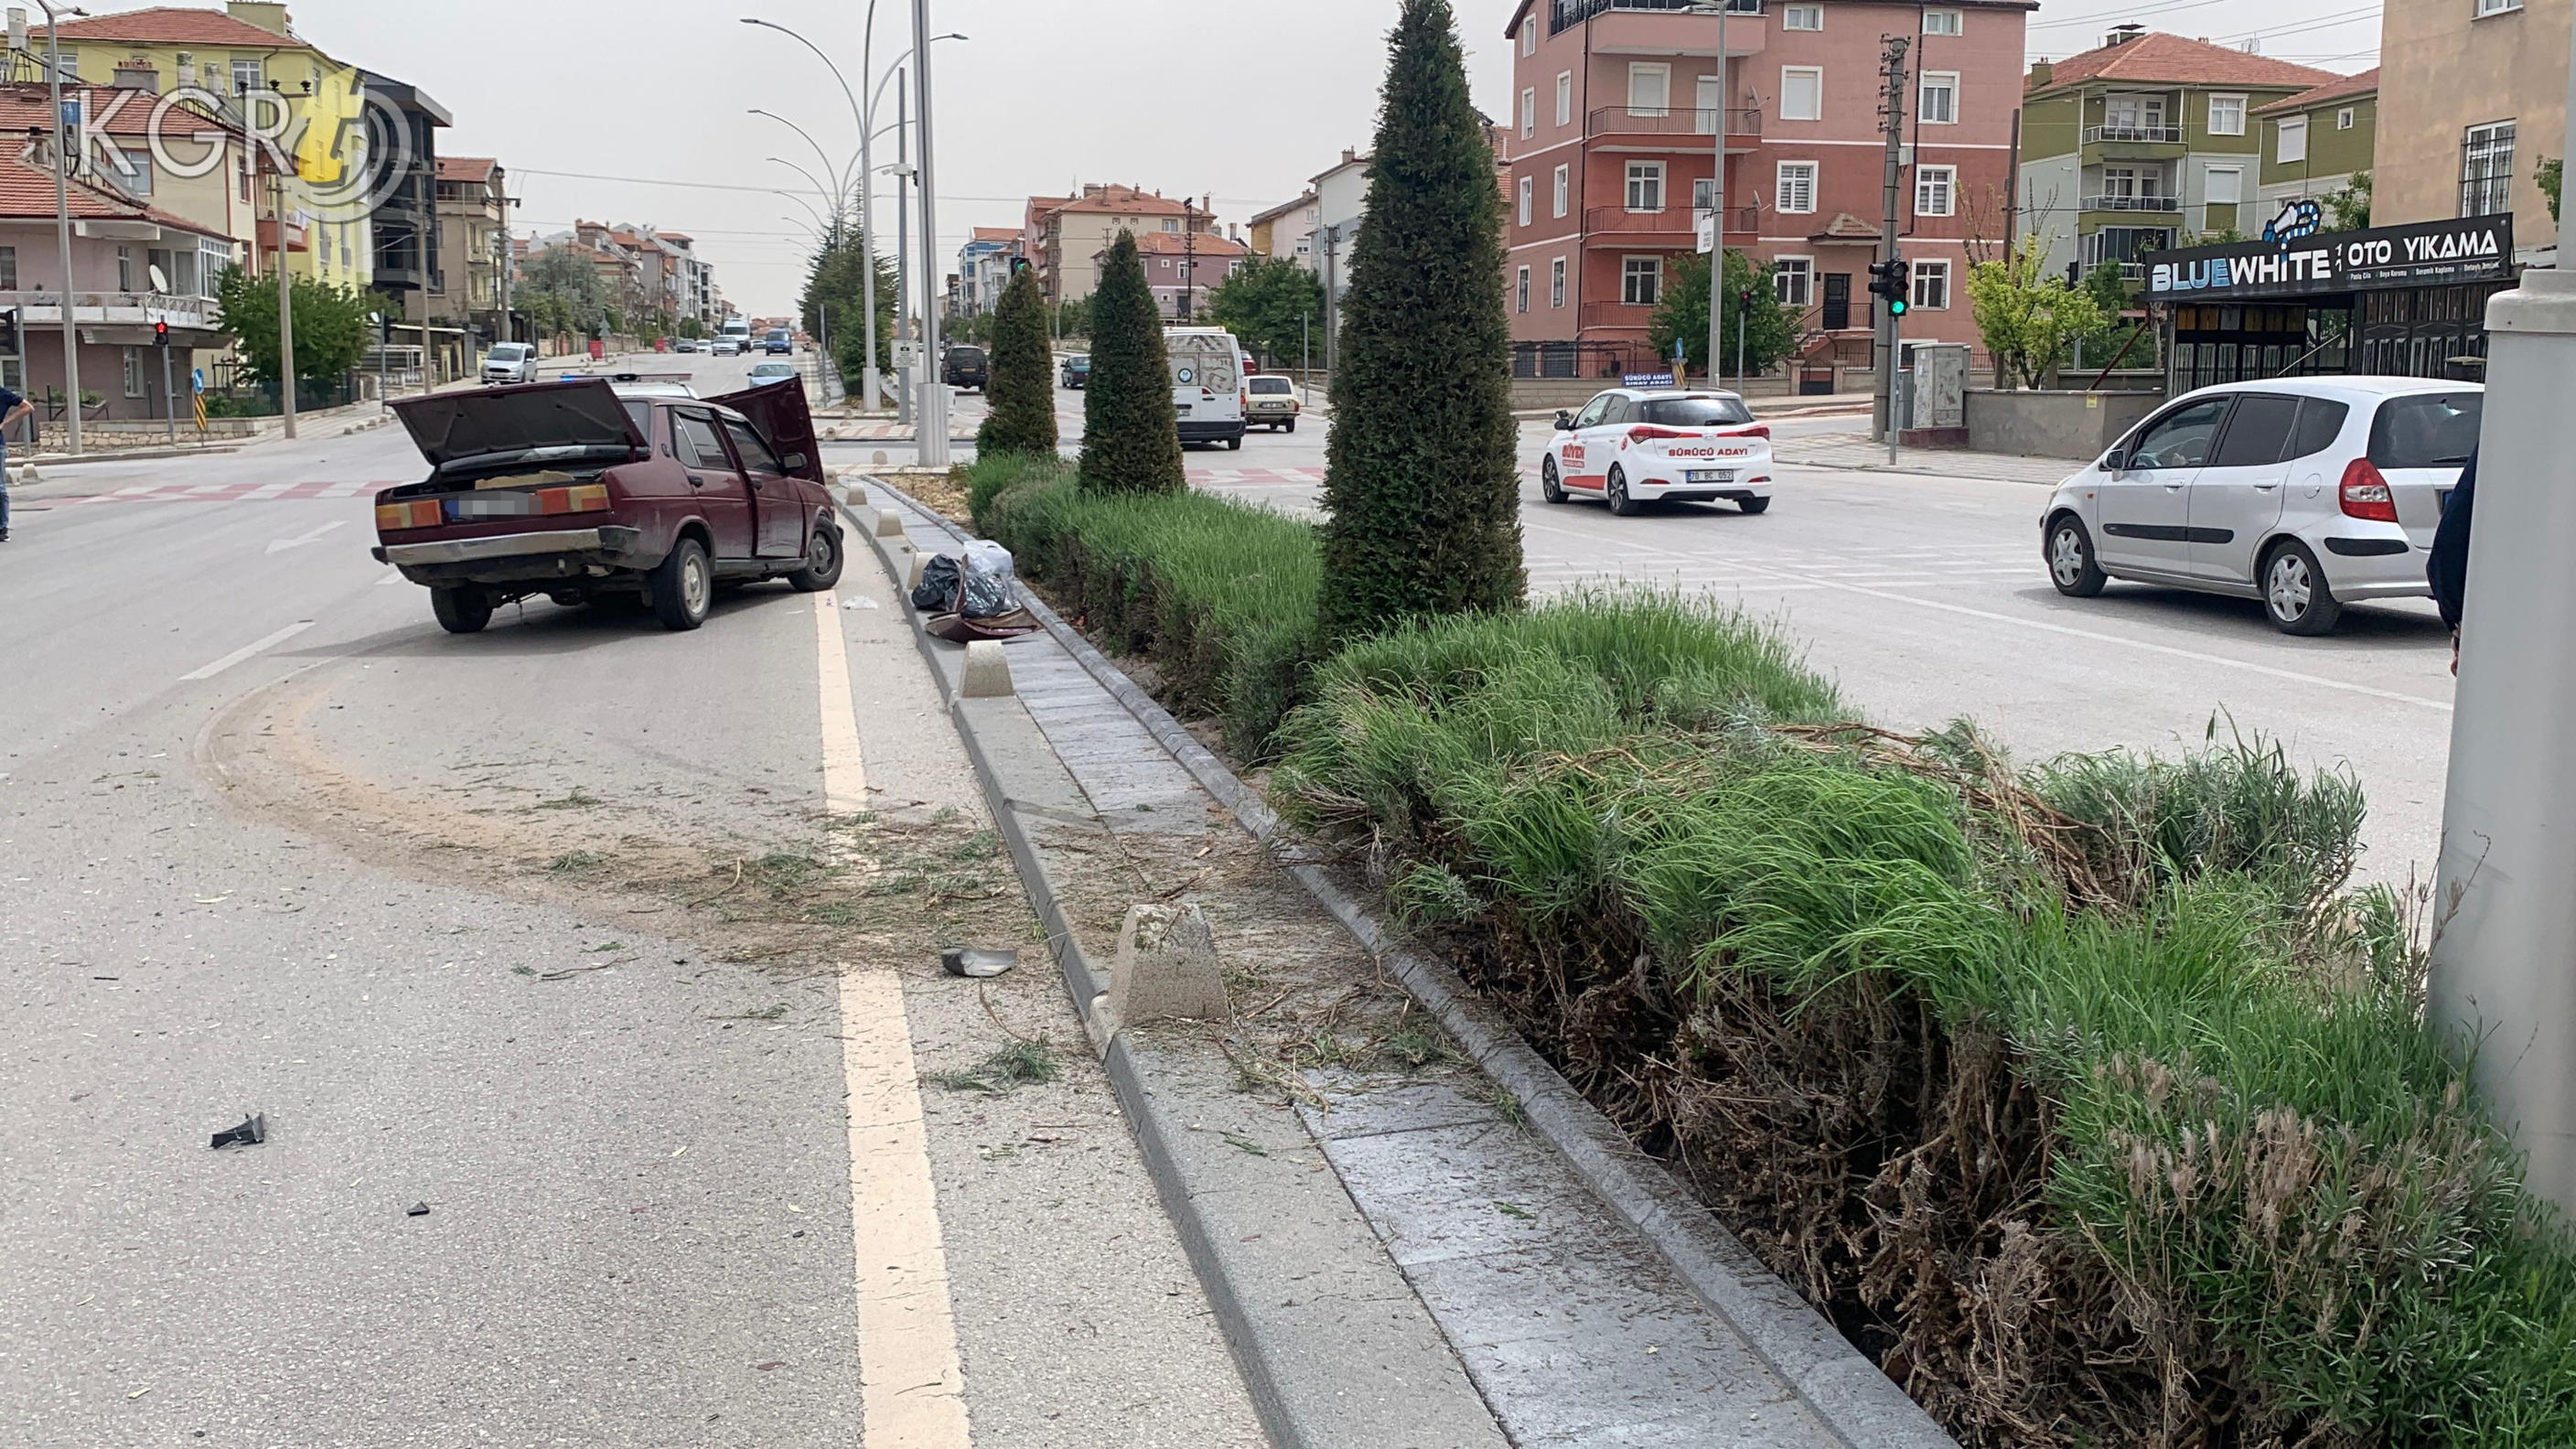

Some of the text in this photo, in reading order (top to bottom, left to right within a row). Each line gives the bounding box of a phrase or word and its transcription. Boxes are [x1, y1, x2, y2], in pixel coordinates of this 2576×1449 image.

[2347, 230, 2498, 266] OTO YIKAMA
[1669, 447, 1714, 456] SÜRÜCÜ
[1690, 472, 1700, 480] 70
